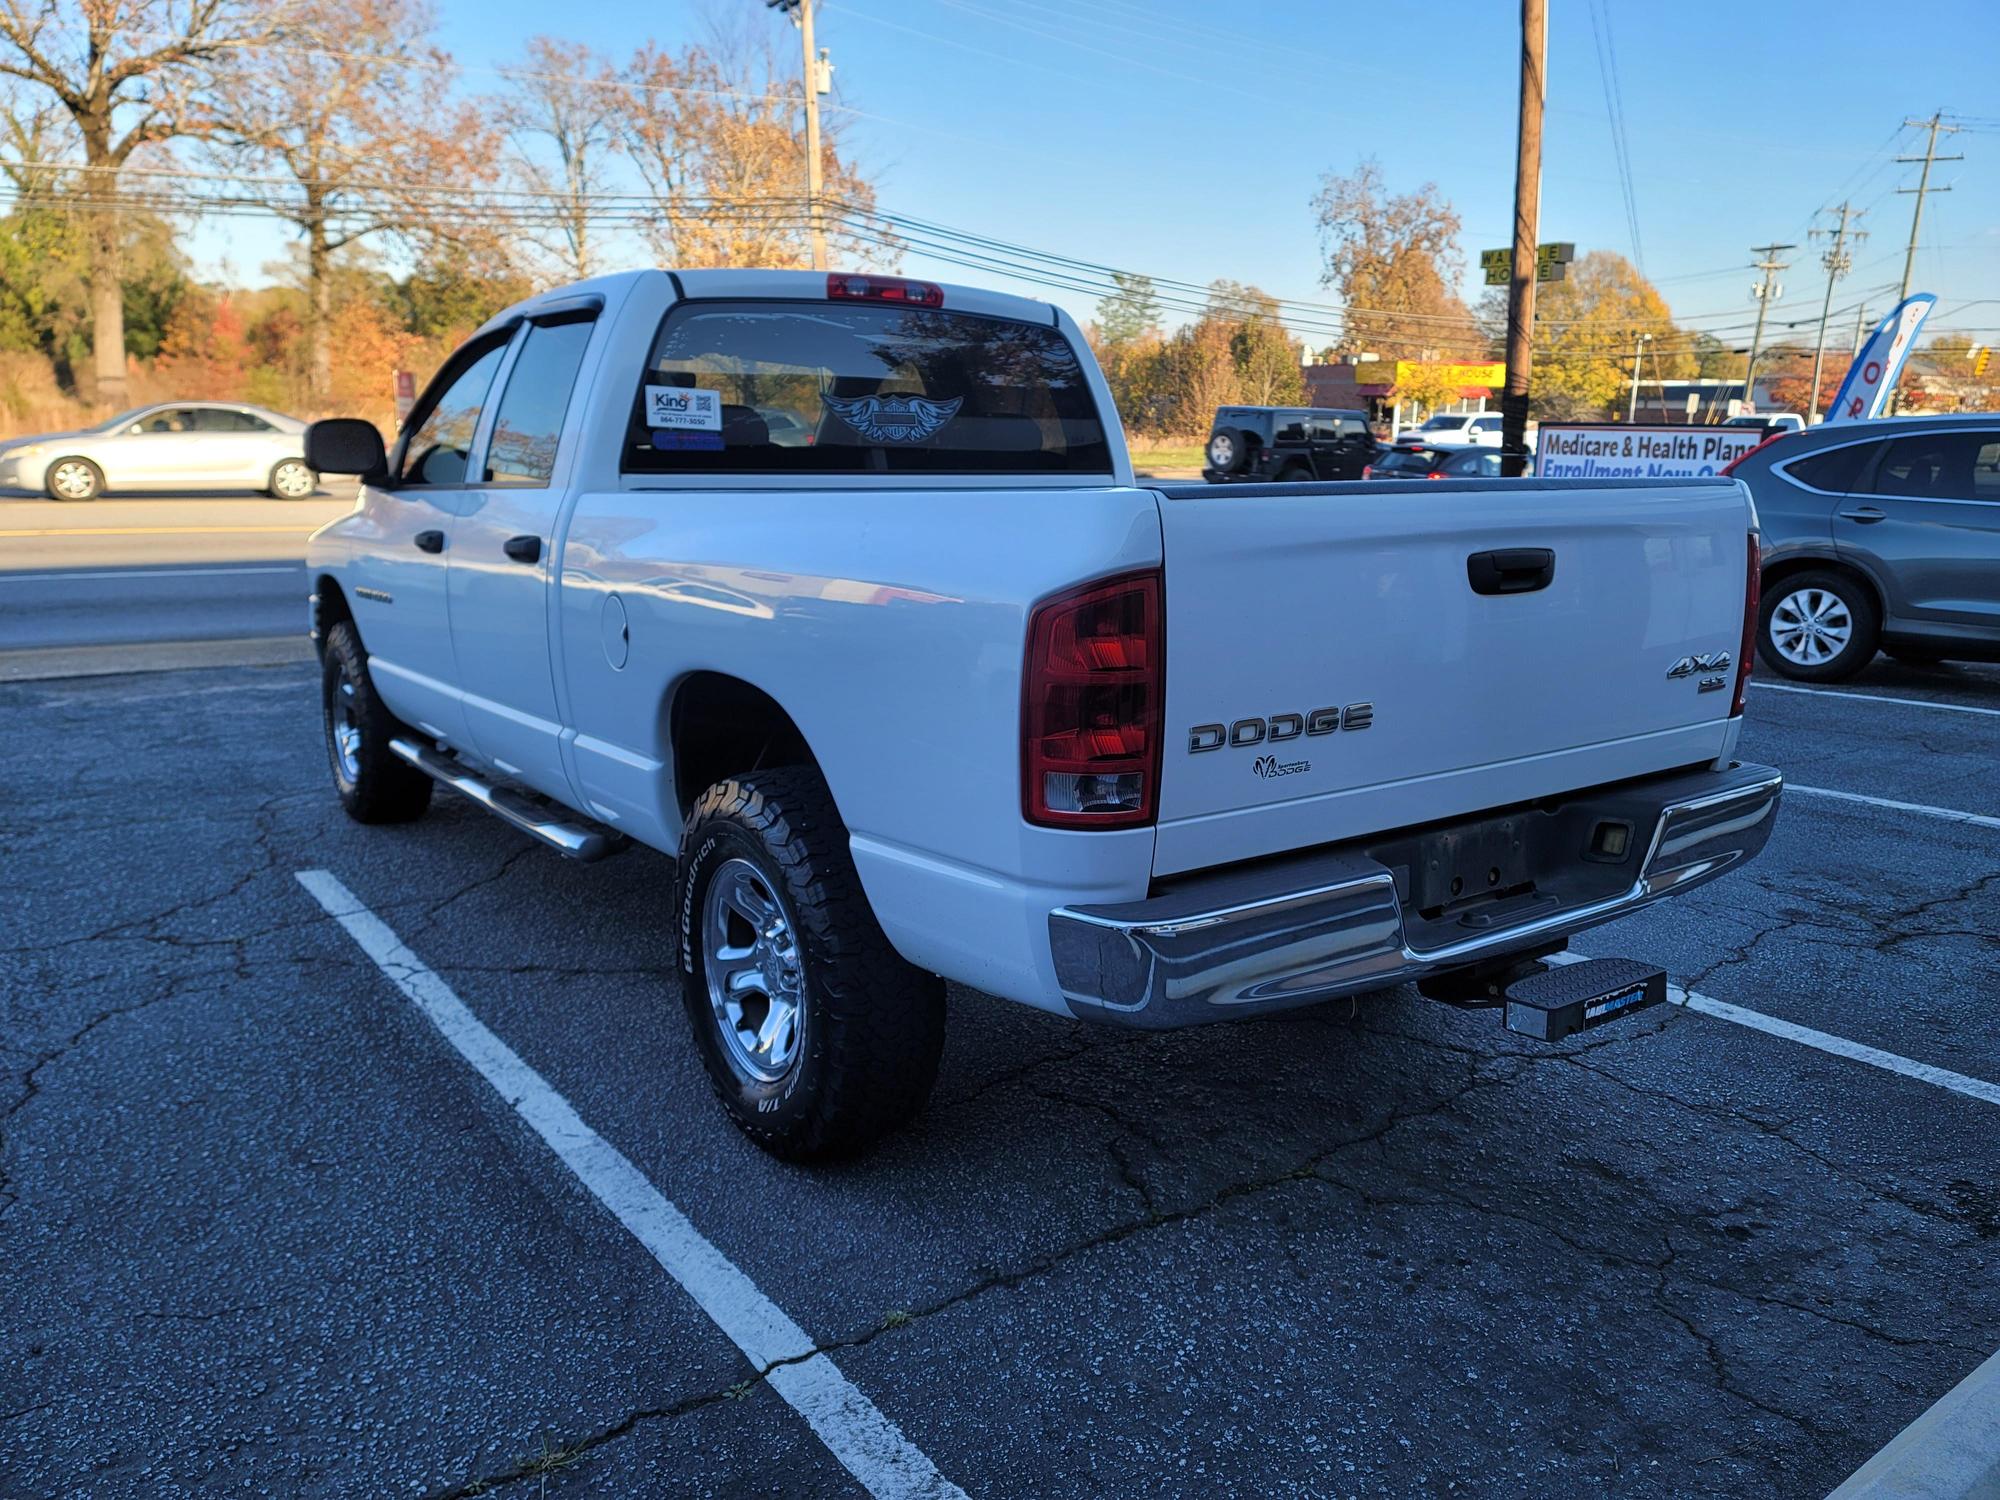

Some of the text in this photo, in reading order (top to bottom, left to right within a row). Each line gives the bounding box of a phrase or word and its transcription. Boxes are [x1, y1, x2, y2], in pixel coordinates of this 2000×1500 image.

[655, 393, 689, 411] King
[1546, 434, 1618, 457] Medicare
[1623, 436, 1633, 458] &
[1638, 436, 1697, 460] Health
[1188, 701, 1373, 754] DODGE
[1268, 764, 1312, 778] DODGE
[682, 837, 716, 974] BFGoodrich
